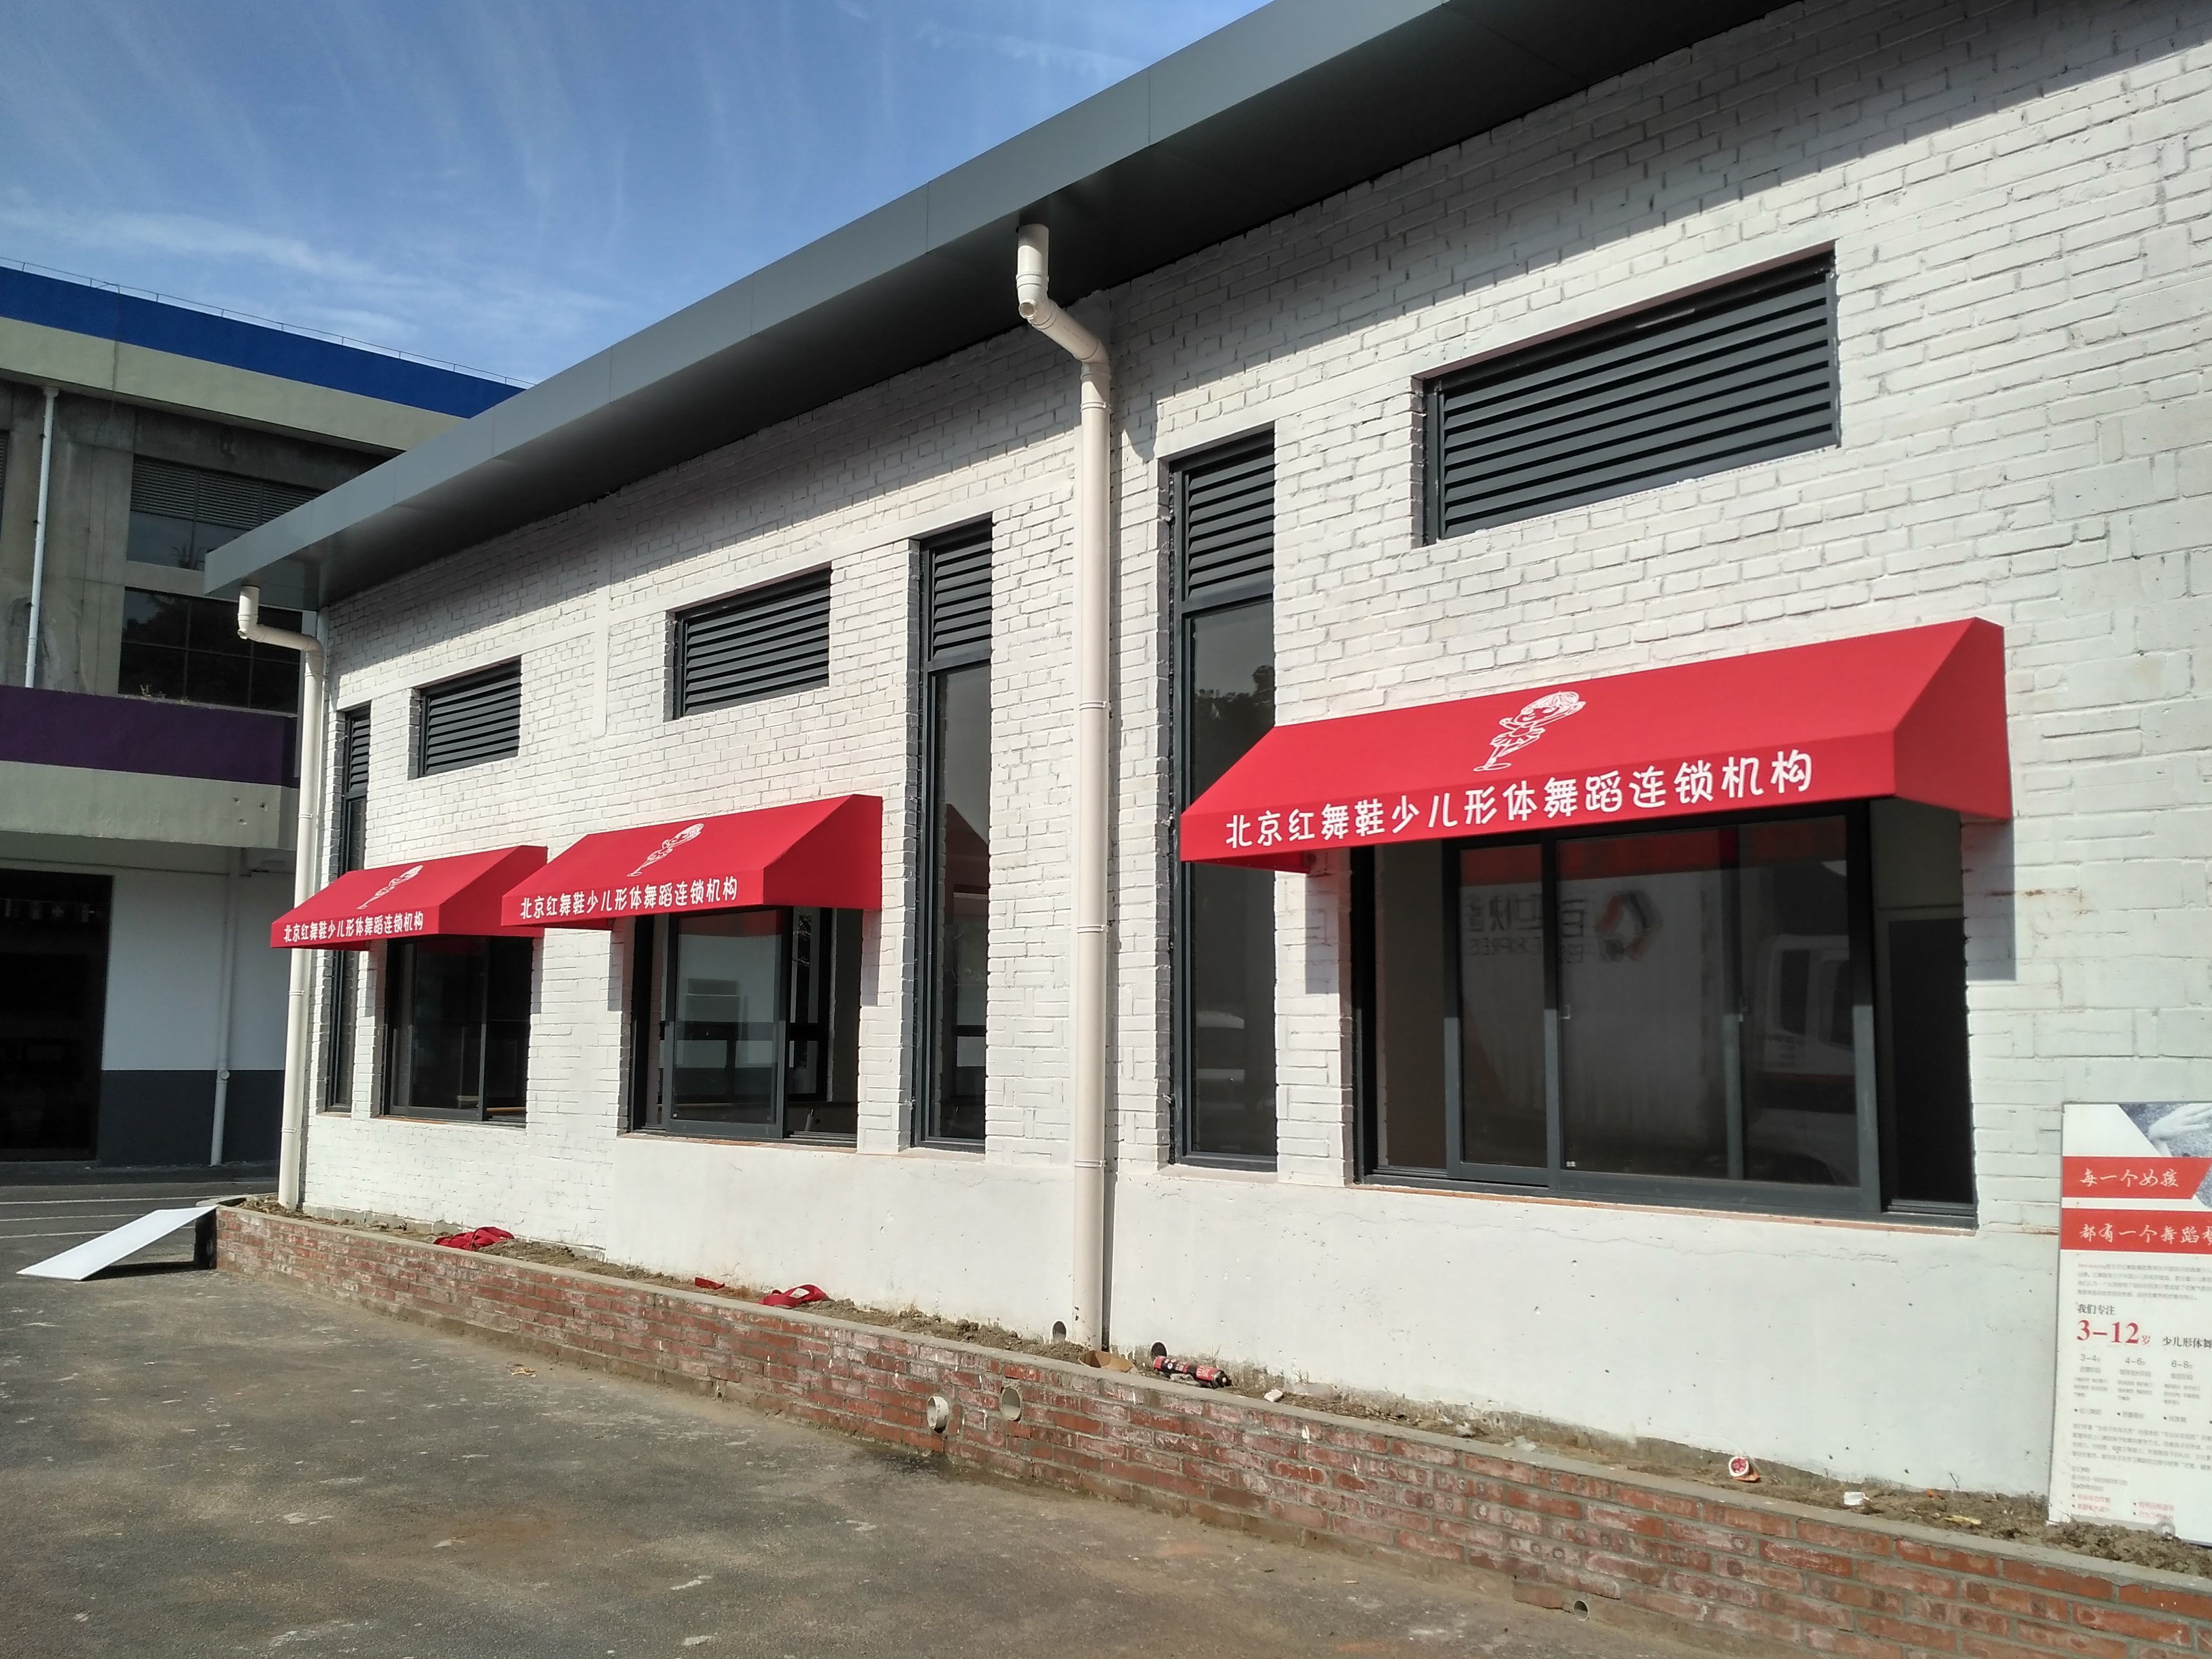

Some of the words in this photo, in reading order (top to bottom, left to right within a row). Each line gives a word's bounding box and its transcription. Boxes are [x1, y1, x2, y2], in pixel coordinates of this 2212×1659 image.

[1225, 749, 1812, 849] 北京红舞鞋少儿形体舞蹈连锁机构
[520, 876, 737, 919] 北京红舞鞋少儿形体舞蹈连锁机构
[283, 910, 424, 943] 北京红舞鞋少儿形体舞蹈连锁机构
[2080, 1168, 2179, 1187] 每一个女孩
[2077, 1304, 2115, 1316] 我们专注
